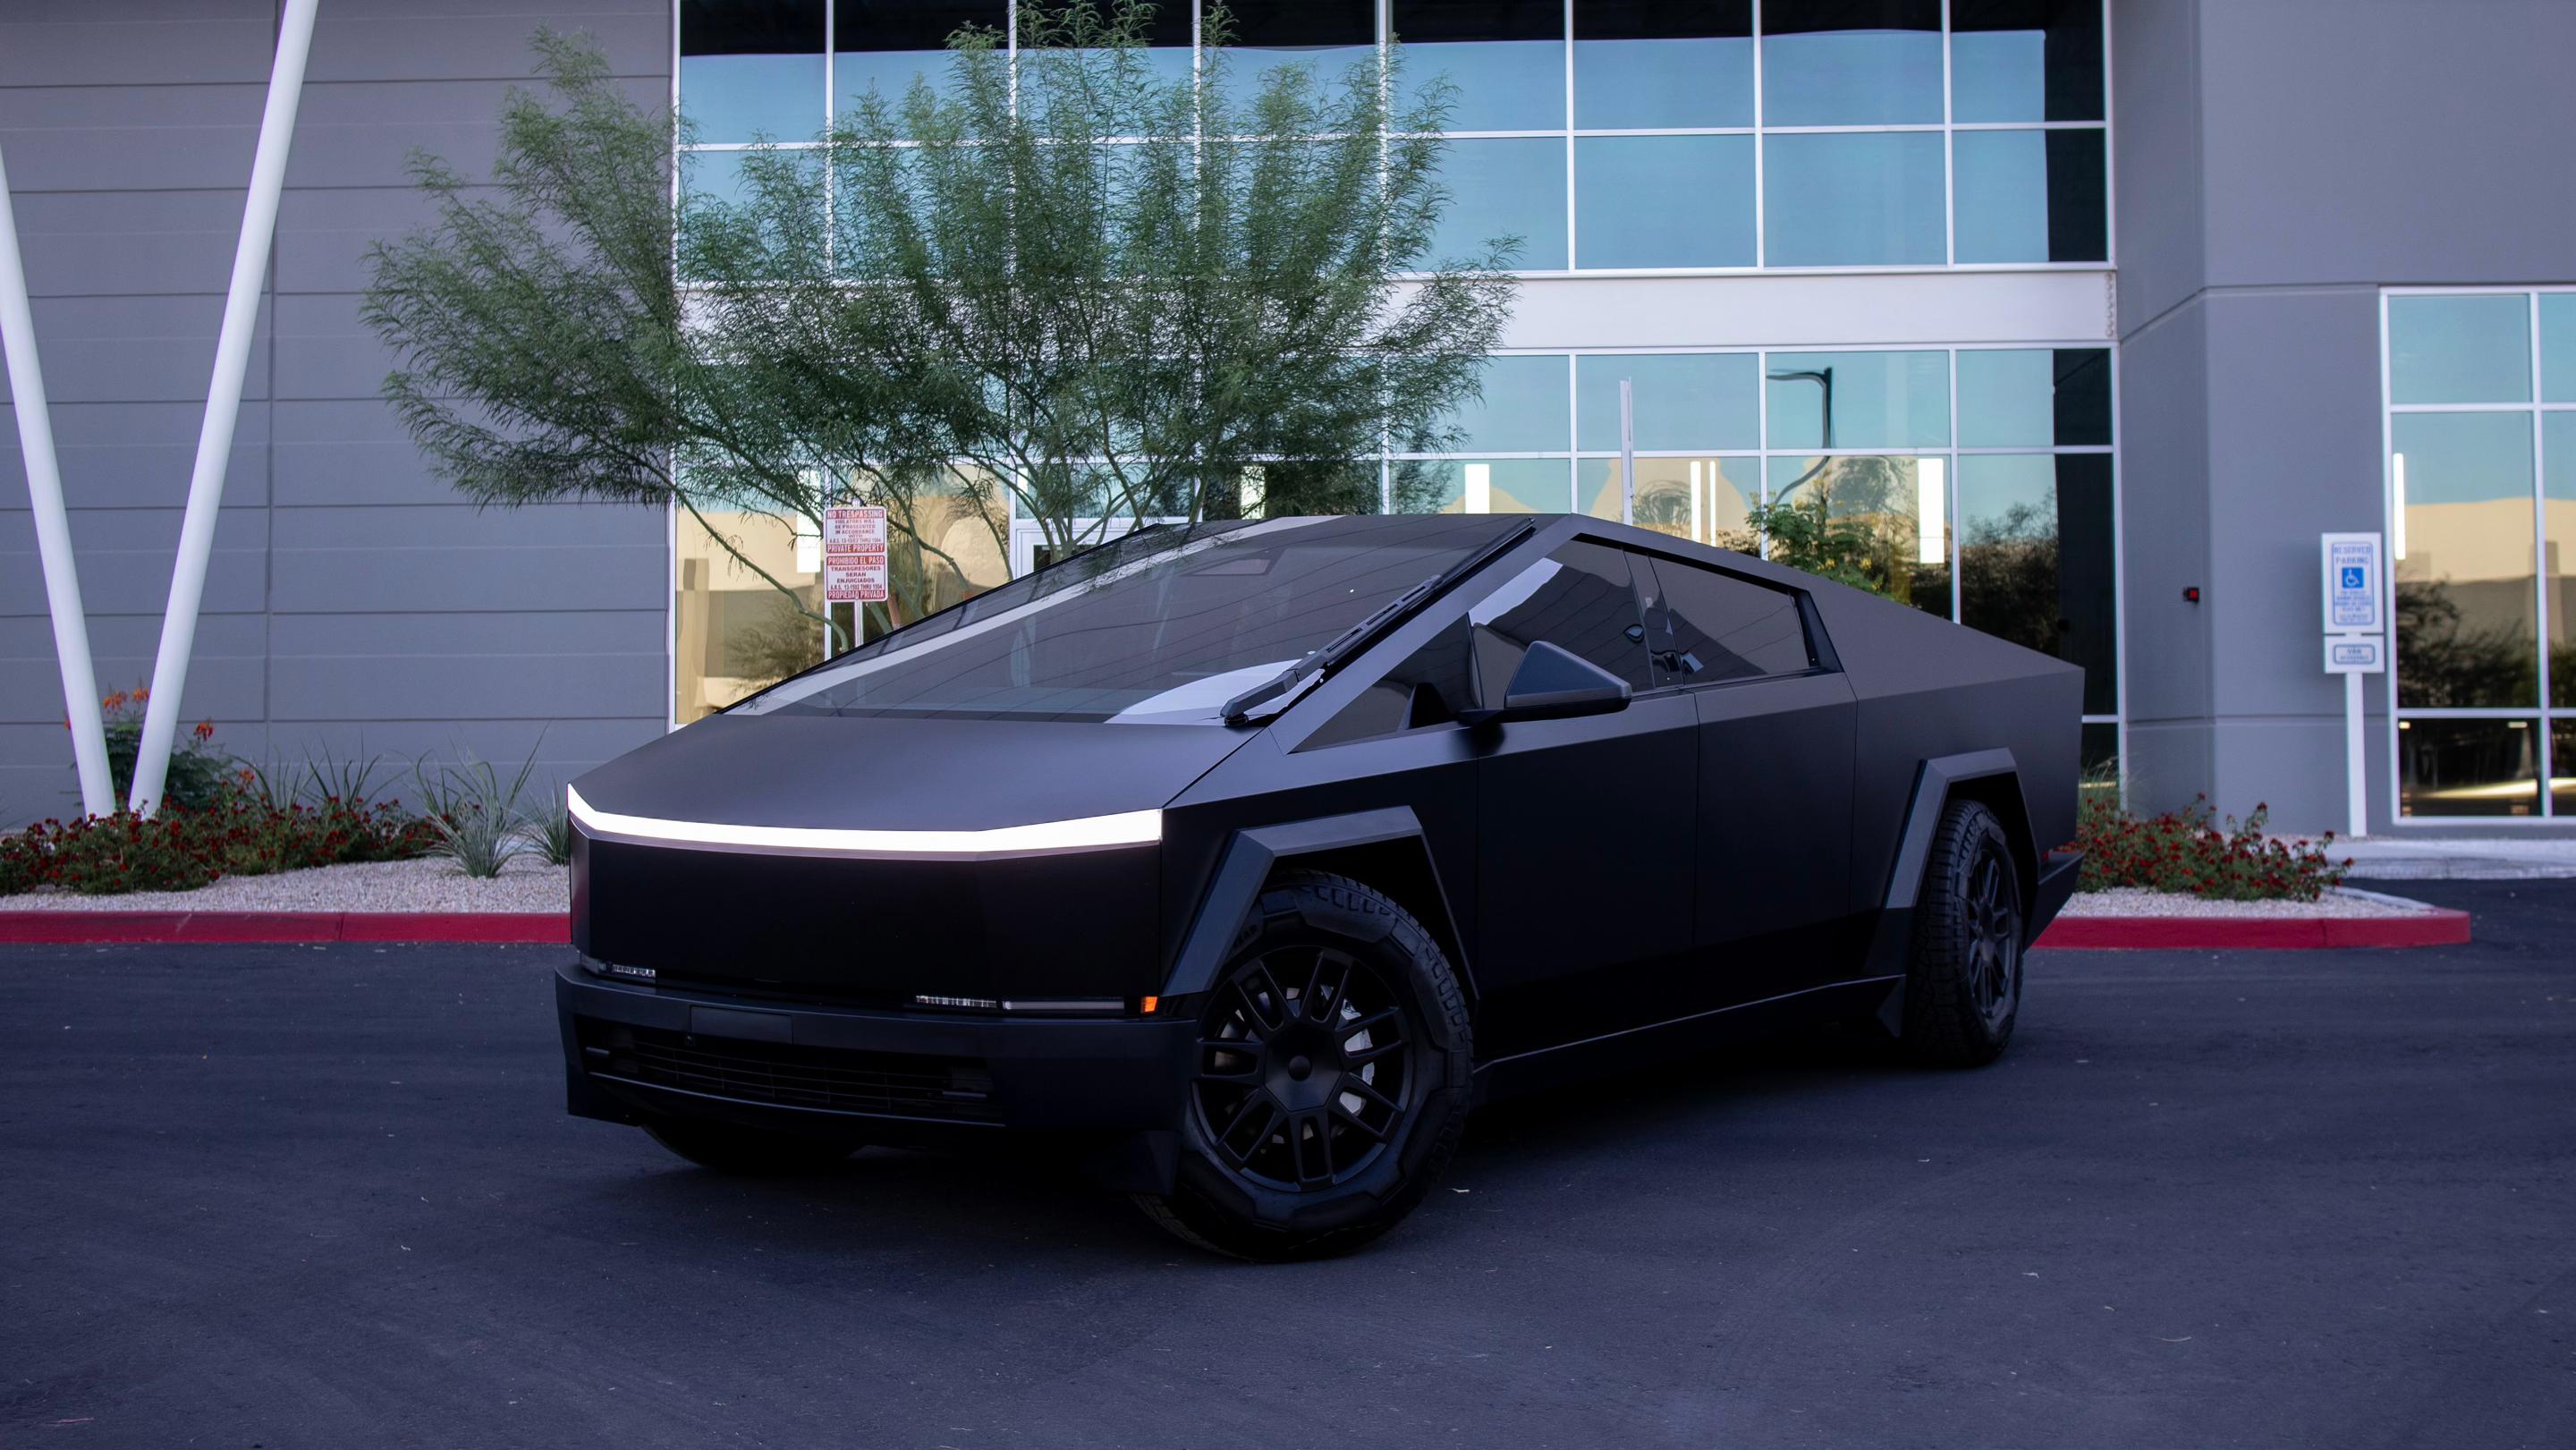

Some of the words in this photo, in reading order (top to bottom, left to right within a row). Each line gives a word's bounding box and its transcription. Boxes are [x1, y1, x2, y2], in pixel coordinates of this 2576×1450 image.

[838, 510, 883, 518] TRESPASSING
[827, 544, 851, 552] PRIVATE
[853, 544, 883, 552] PROPERTY
[2335, 556, 2369, 564] PARKING
[860, 590, 884, 598] PRIVADA
